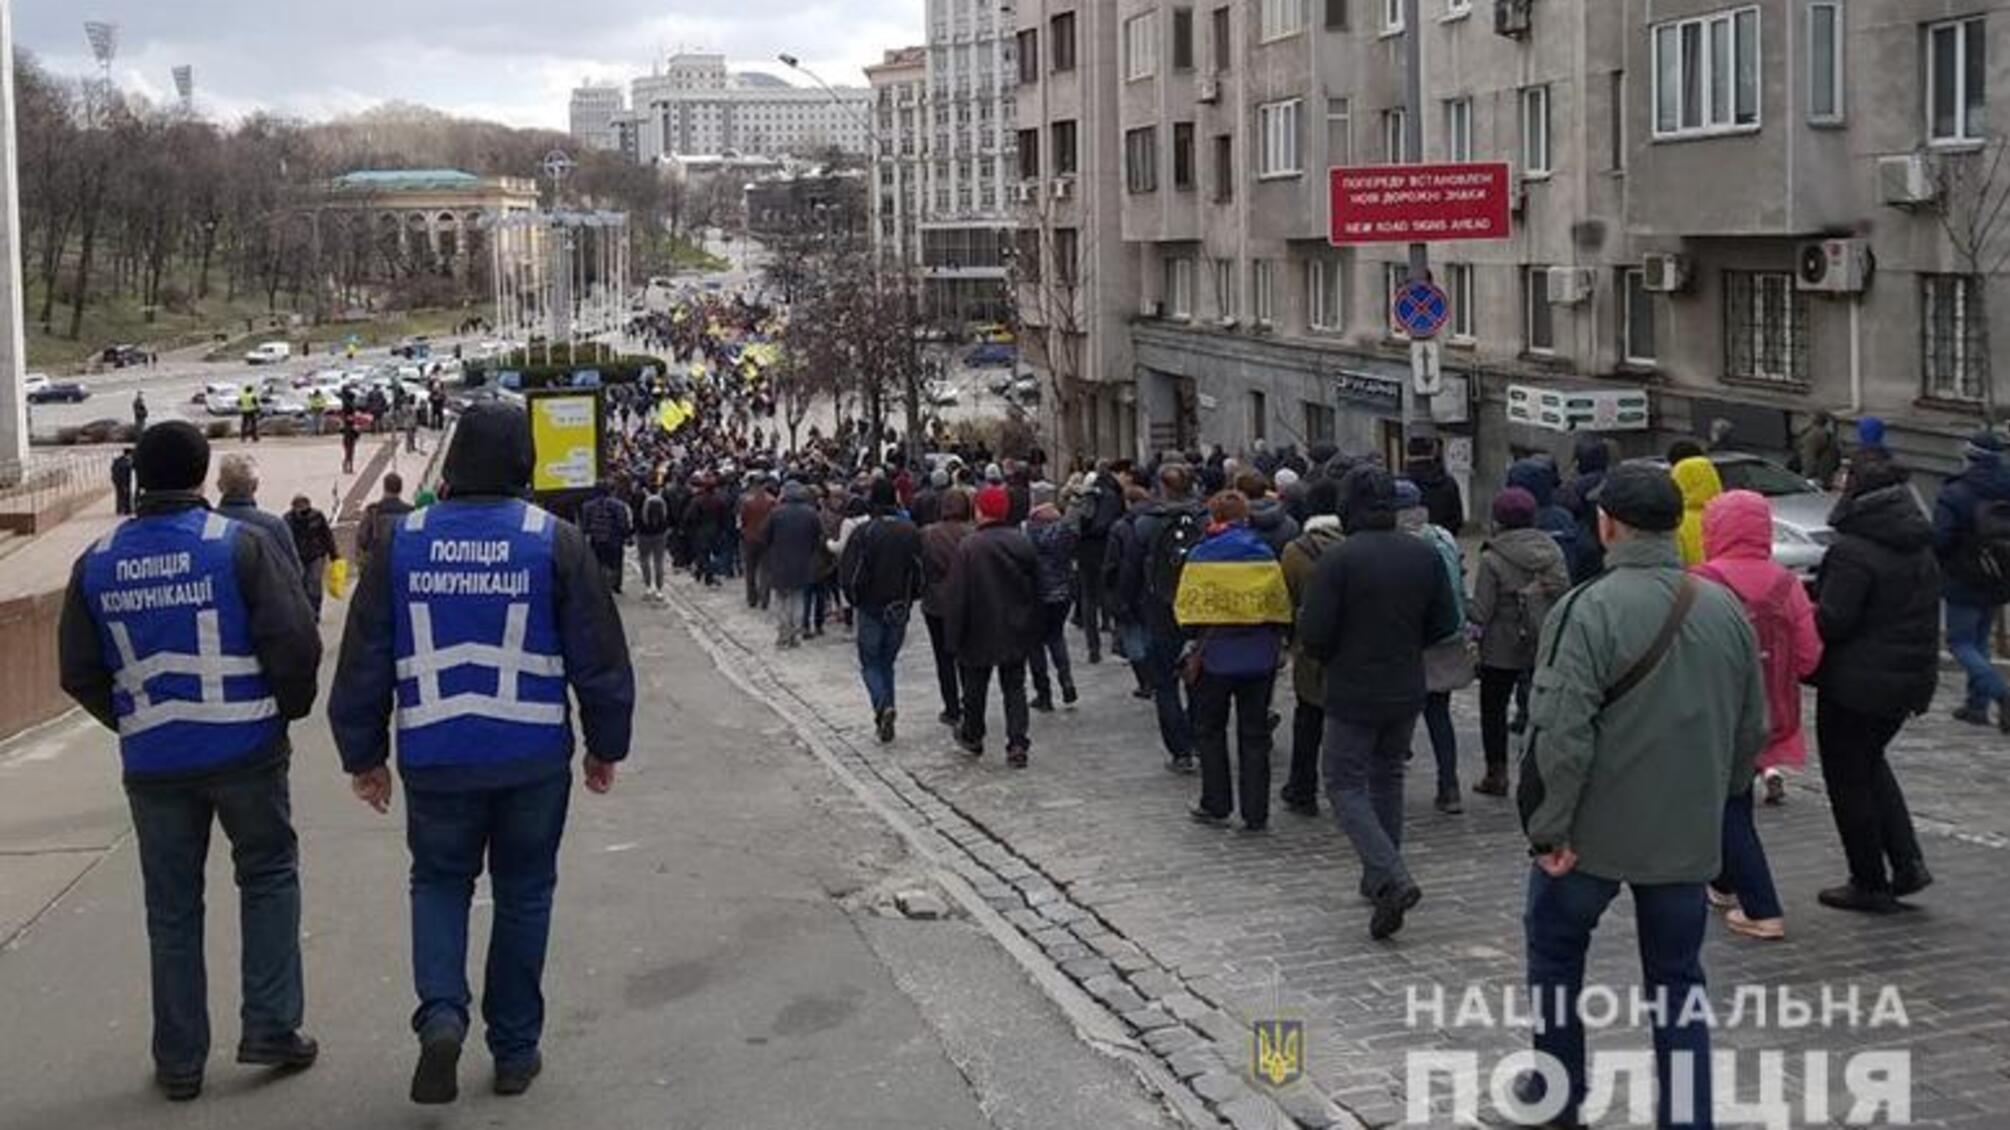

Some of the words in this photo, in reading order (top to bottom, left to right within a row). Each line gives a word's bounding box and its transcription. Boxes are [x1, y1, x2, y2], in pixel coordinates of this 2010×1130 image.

[1345, 222, 1373, 234] NEW
[1376, 221, 1409, 232] ROAD
[1412, 219, 1447, 231] SIGNS
[1451, 217, 1492, 230] AHEAD
[116, 552, 191, 582] ПОЛІЦІЯ
[430, 540, 510, 567] ПОЛІЦІЯ
[100, 575, 214, 613] КОМУНІКАЦІЇ
[408, 568, 530, 598] КОМУНІКАЦІЇ
